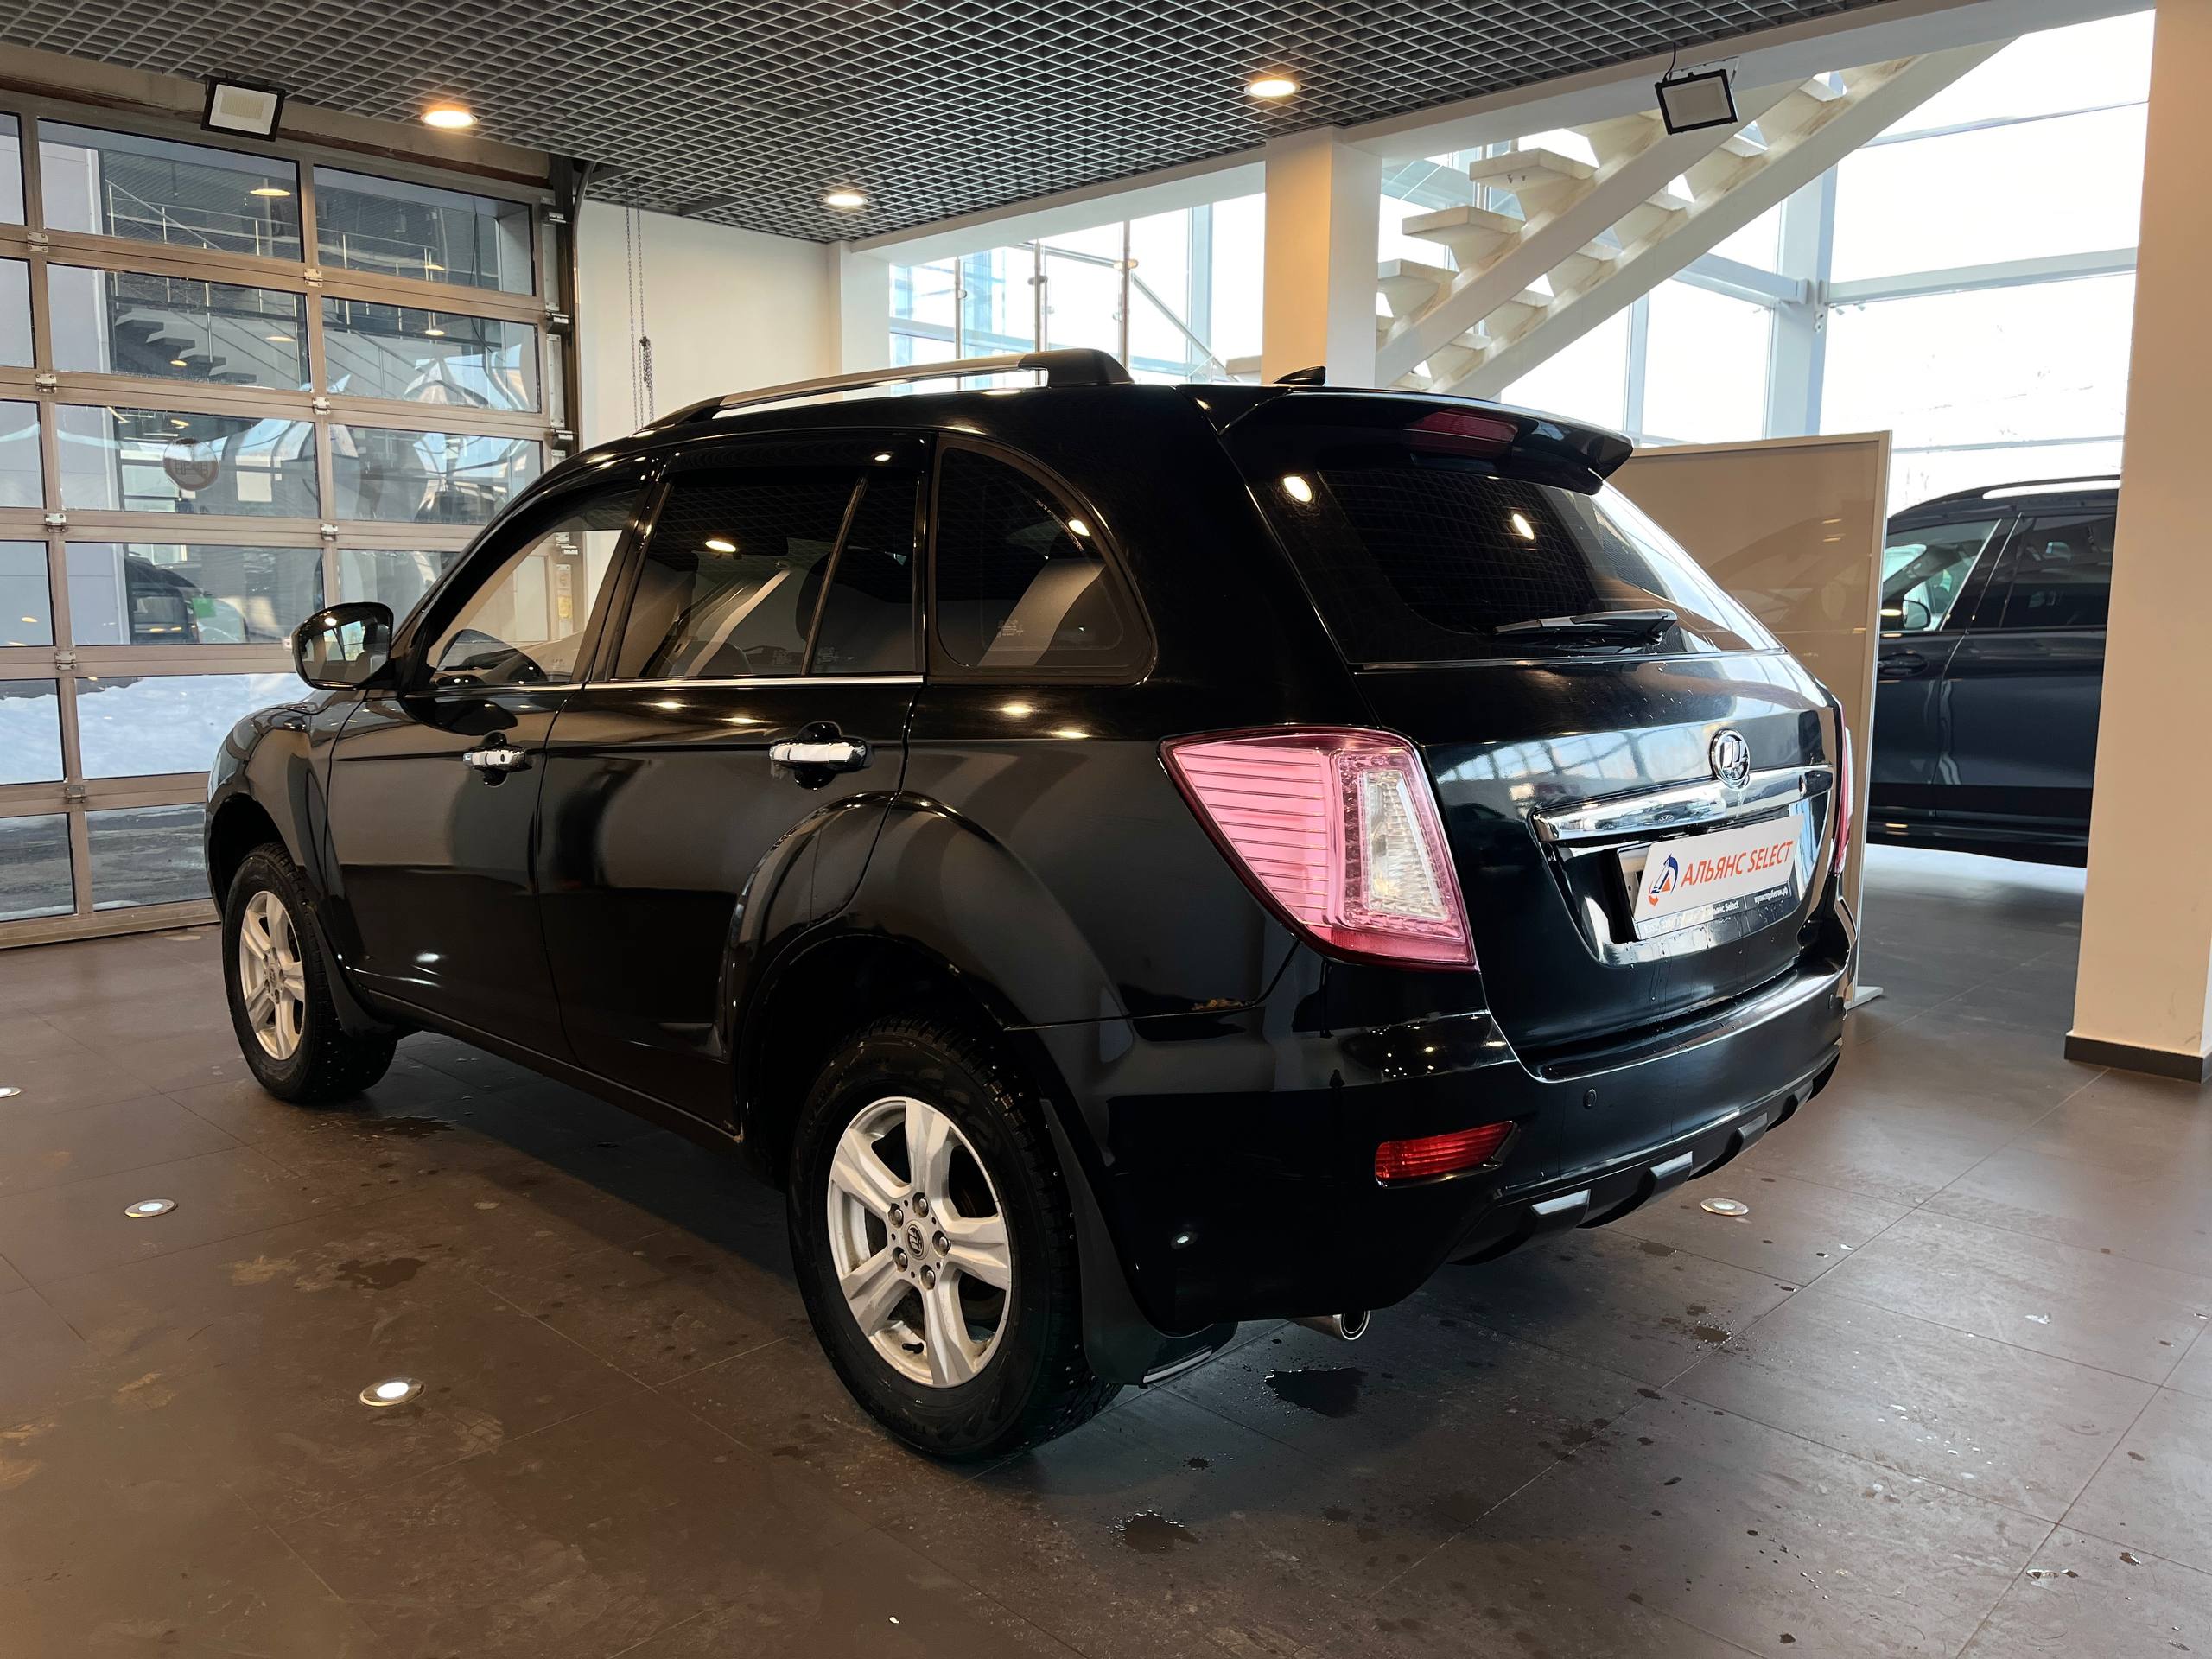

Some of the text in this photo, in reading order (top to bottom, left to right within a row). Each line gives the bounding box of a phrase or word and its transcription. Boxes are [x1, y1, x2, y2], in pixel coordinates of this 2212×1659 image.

[1680, 841, 1794, 887] АЛЬЯНС SELECT
[1725, 899, 1740, 912] Select
